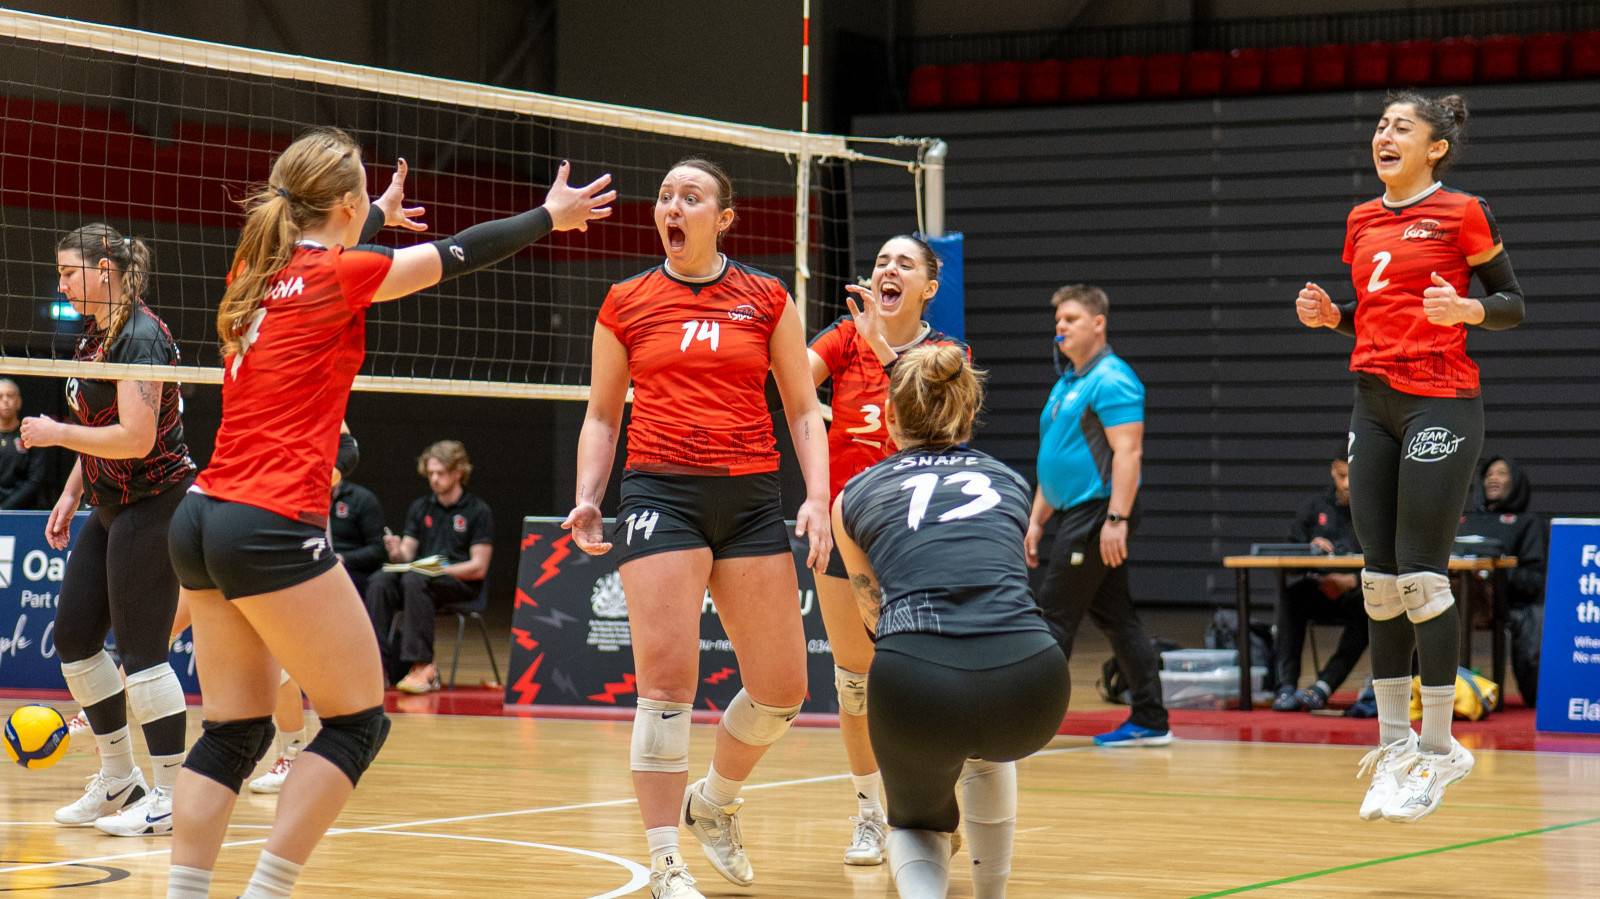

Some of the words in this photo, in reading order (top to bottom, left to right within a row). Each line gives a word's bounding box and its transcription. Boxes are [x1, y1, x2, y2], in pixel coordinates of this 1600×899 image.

[1367, 251, 1391, 292] 2
[680, 320, 719, 352] 14
[846, 404, 881, 434] 3
[1404, 434, 1466, 460] SIDEOUT
[1416, 431, 1448, 443] TEAM
[900, 471, 1002, 531] 13
[625, 510, 659, 546] 14
[302, 537, 326, 561] 7
[22, 550, 72, 581] Oa
[21, 590, 52, 608] Part
